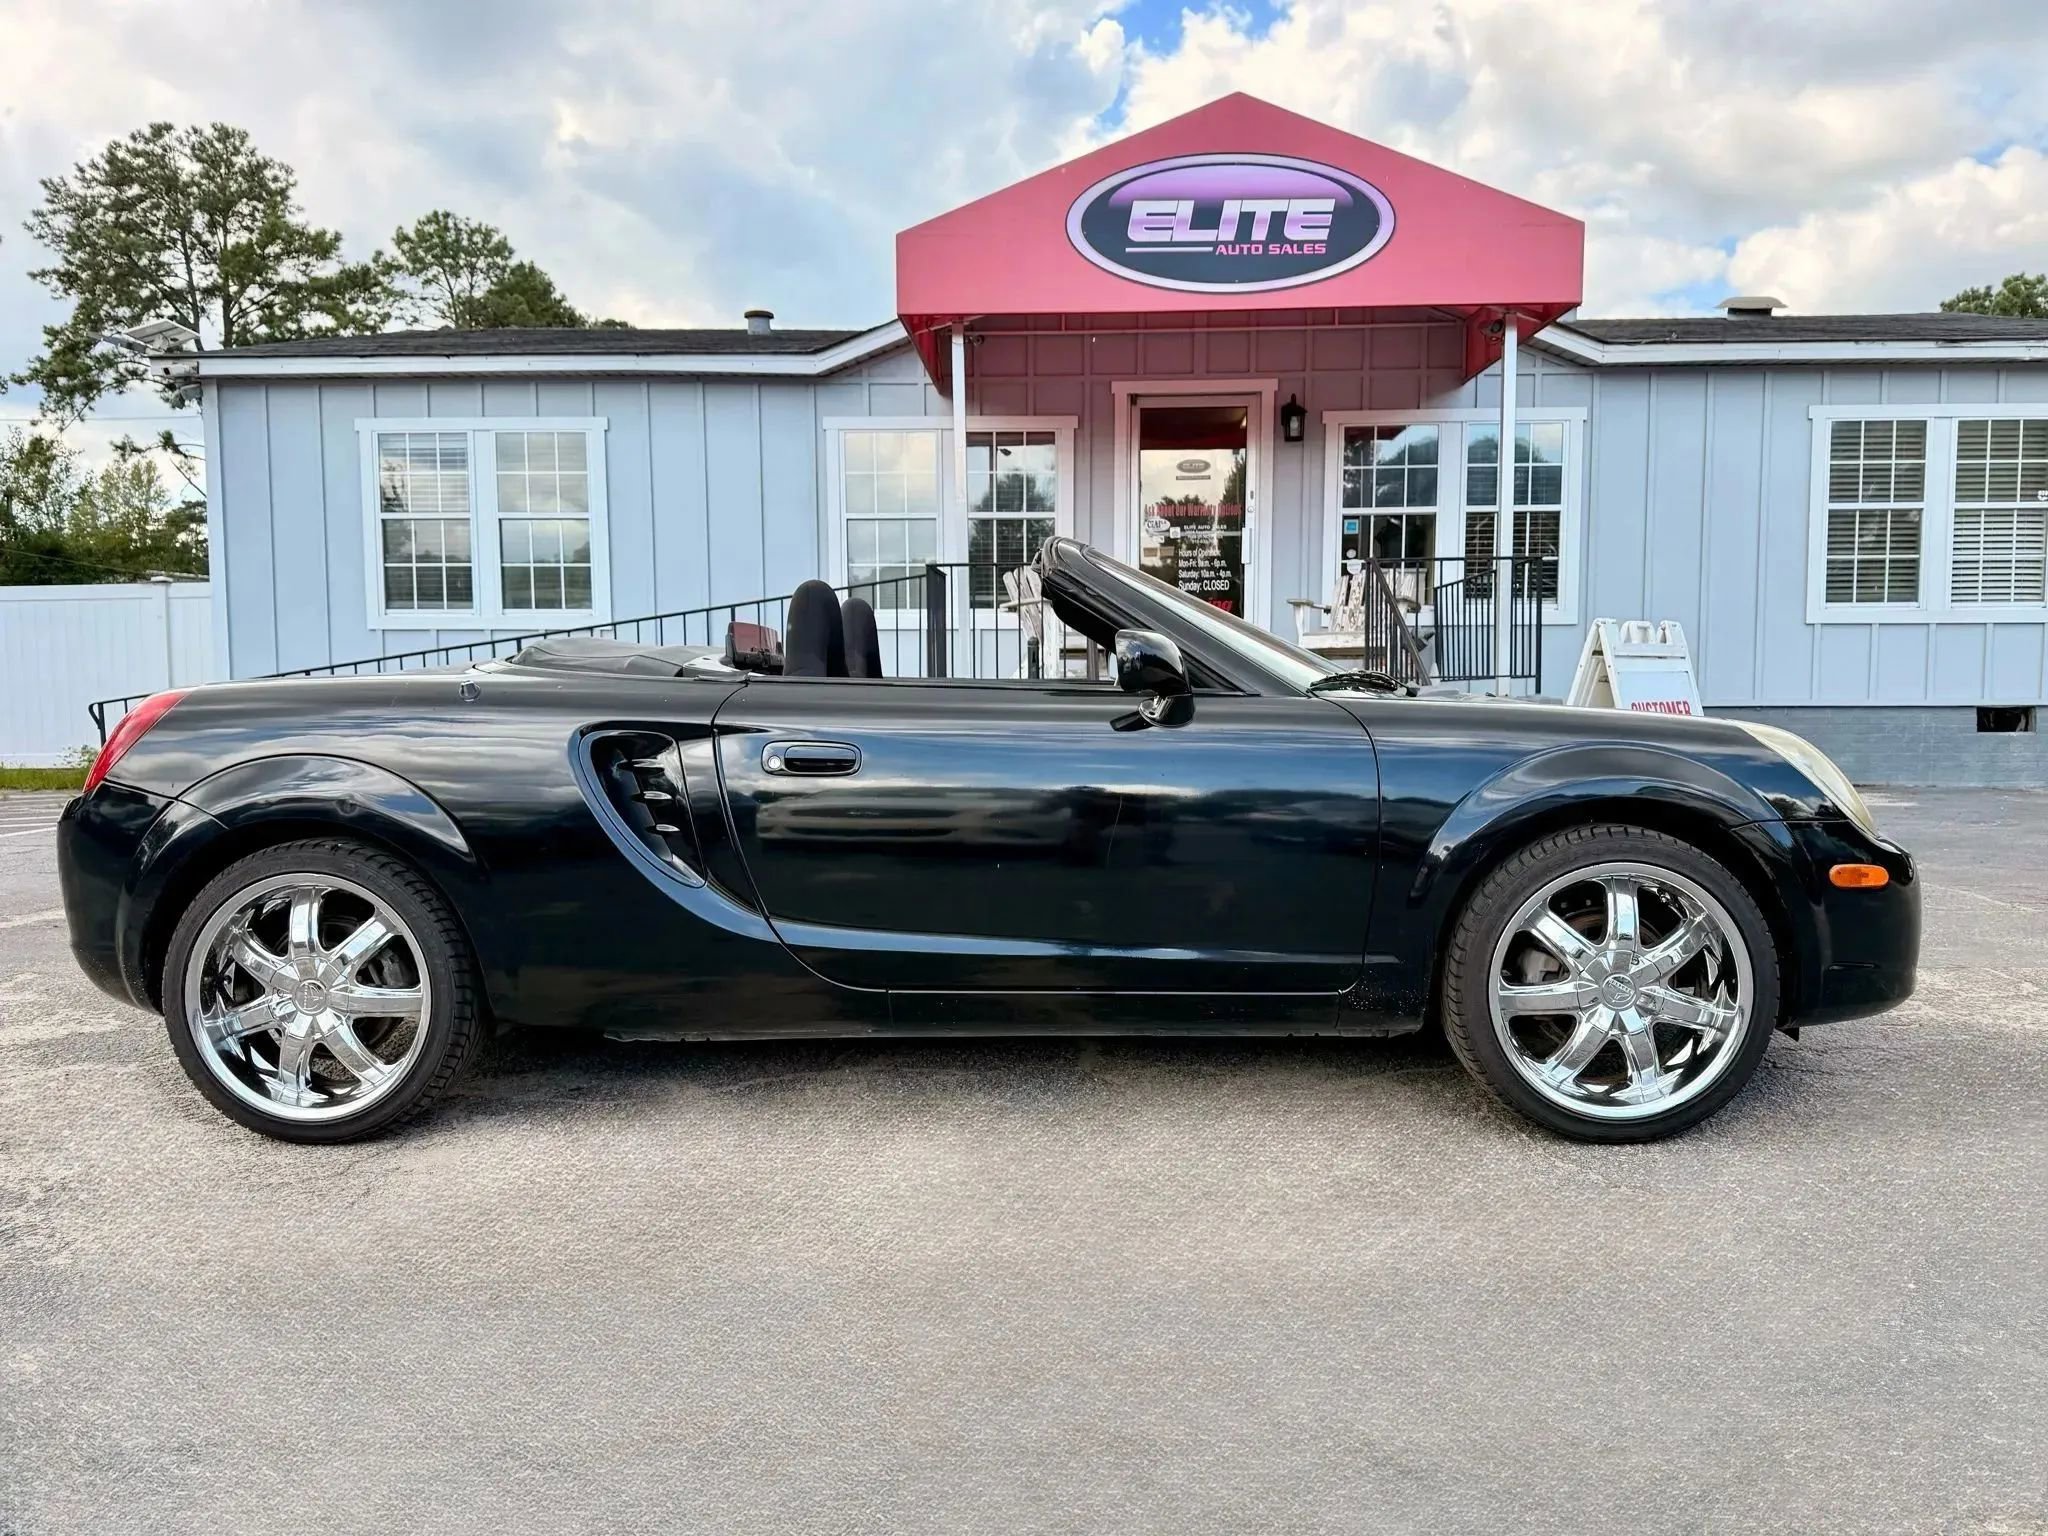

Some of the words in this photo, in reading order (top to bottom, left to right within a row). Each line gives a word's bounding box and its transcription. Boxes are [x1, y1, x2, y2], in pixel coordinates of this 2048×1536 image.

[1127, 198, 1336, 242] ELITE
[1216, 243, 1263, 255] AUTO
[1268, 243, 1326, 255] SALES
[1202, 579, 1230, 591] CLOSED
